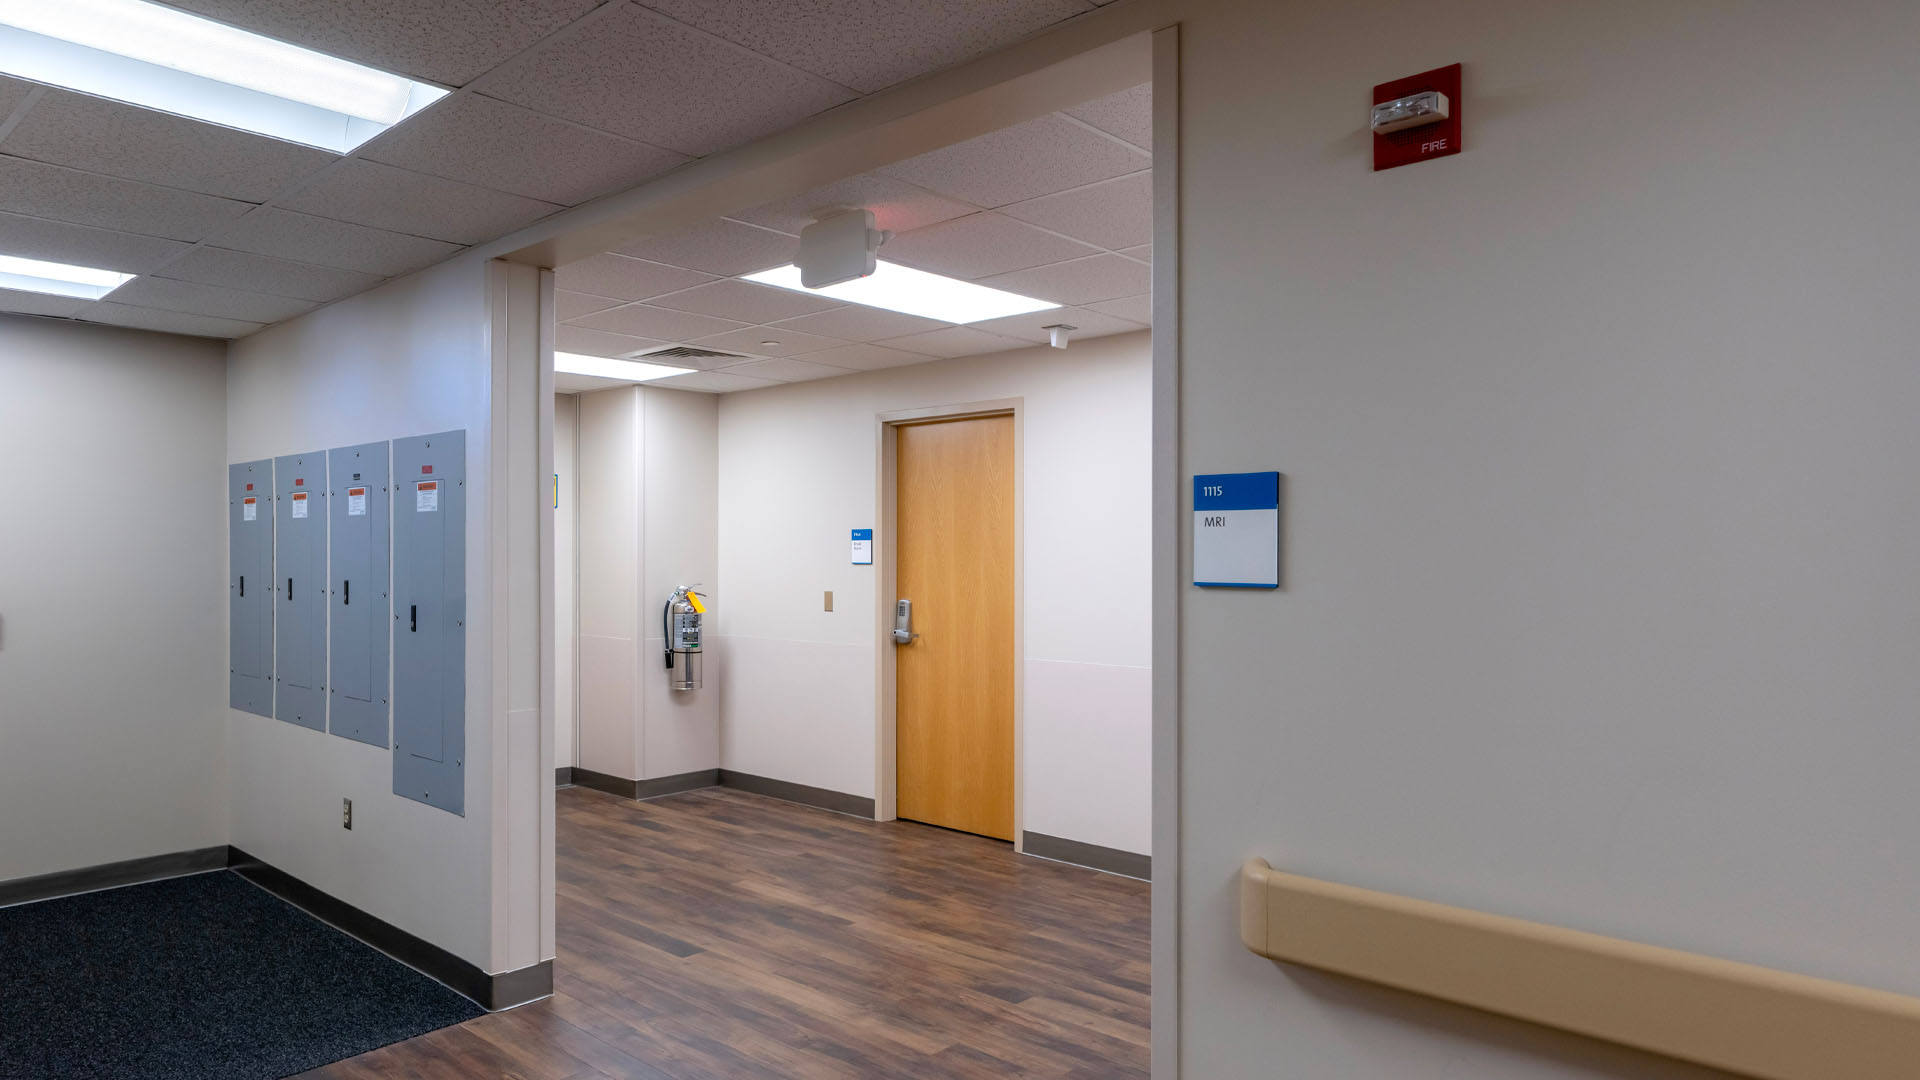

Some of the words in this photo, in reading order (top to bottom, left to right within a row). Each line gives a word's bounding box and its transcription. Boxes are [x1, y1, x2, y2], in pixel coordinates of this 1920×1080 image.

[1421, 138, 1448, 153] FIRE
[1203, 485, 1223, 497] 1115
[1204, 516, 1226, 527] MRI
